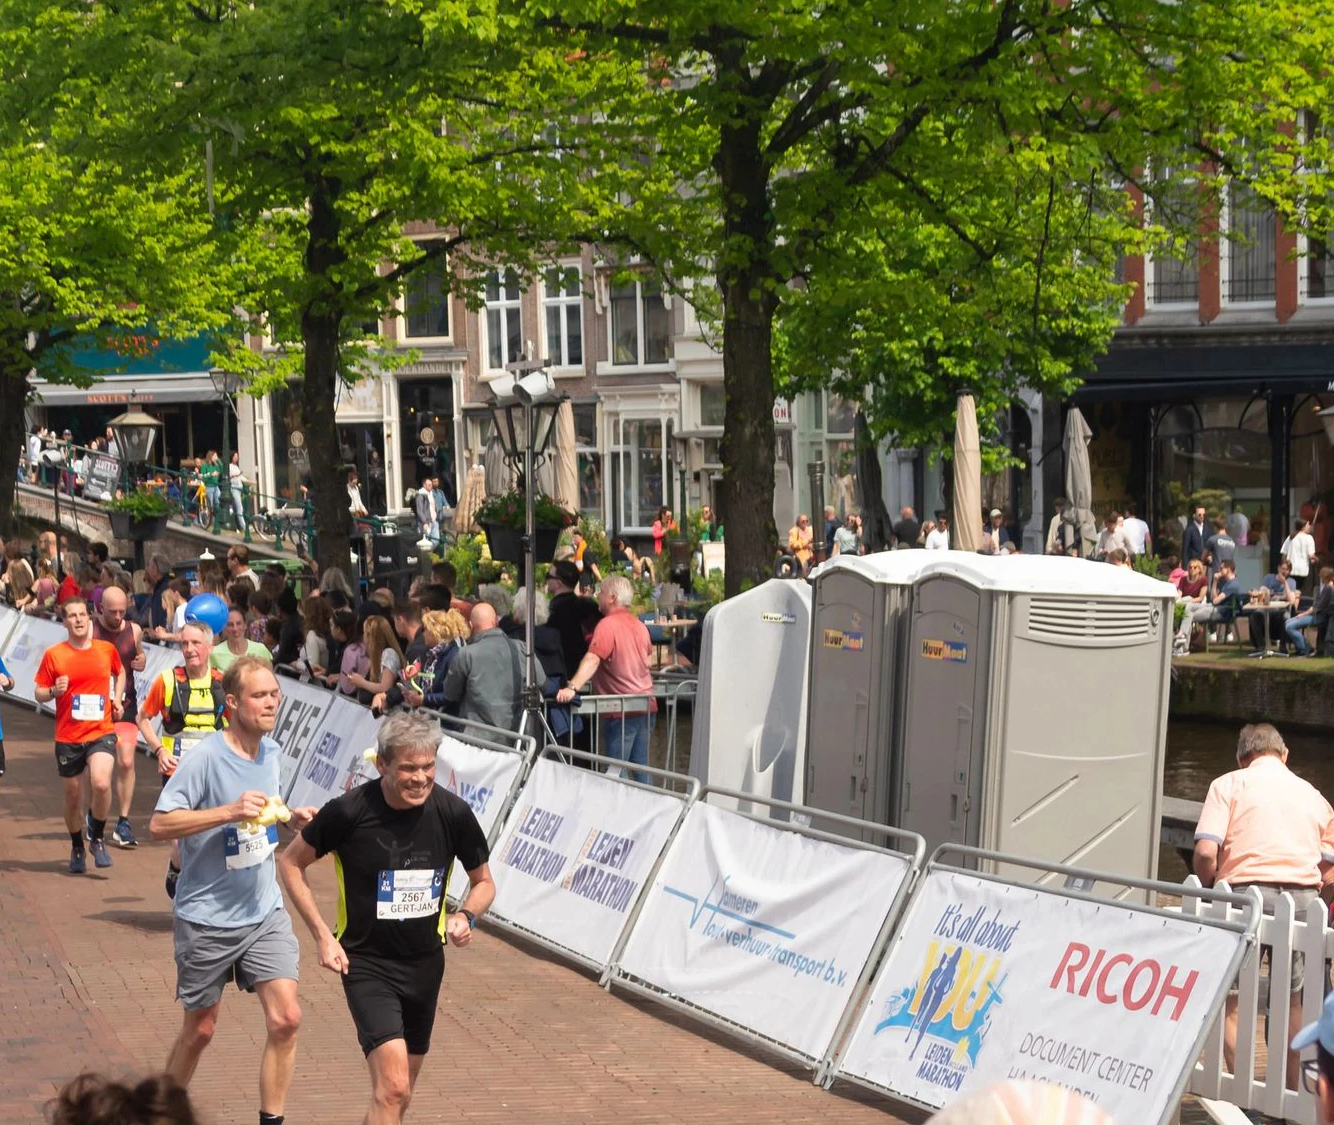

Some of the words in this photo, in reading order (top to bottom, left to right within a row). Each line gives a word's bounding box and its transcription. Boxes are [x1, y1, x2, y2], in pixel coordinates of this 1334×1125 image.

[519, 805, 564, 845] LEIDEN
[245, 840, 263, 852] 5525
[505, 836, 567, 884] MARATHON
[587, 830, 635, 870] LEIDEN
[391, 903, 433, 913] GERT-JAN
[402, 892, 425, 902] 2567
[569, 863, 638, 913] MARATHON
[933, 903, 963, 938] It's
[956, 905, 987, 943] all
[974, 908, 1021, 953] about
[1049, 942, 1200, 1022] RICOH
[924, 1041, 955, 1066] LEIDEN
[1019, 1032, 1101, 1074] DOCUMENT
[1097, 1055, 1154, 1093] CENTER
[916, 1060, 965, 1092] MARATHON
